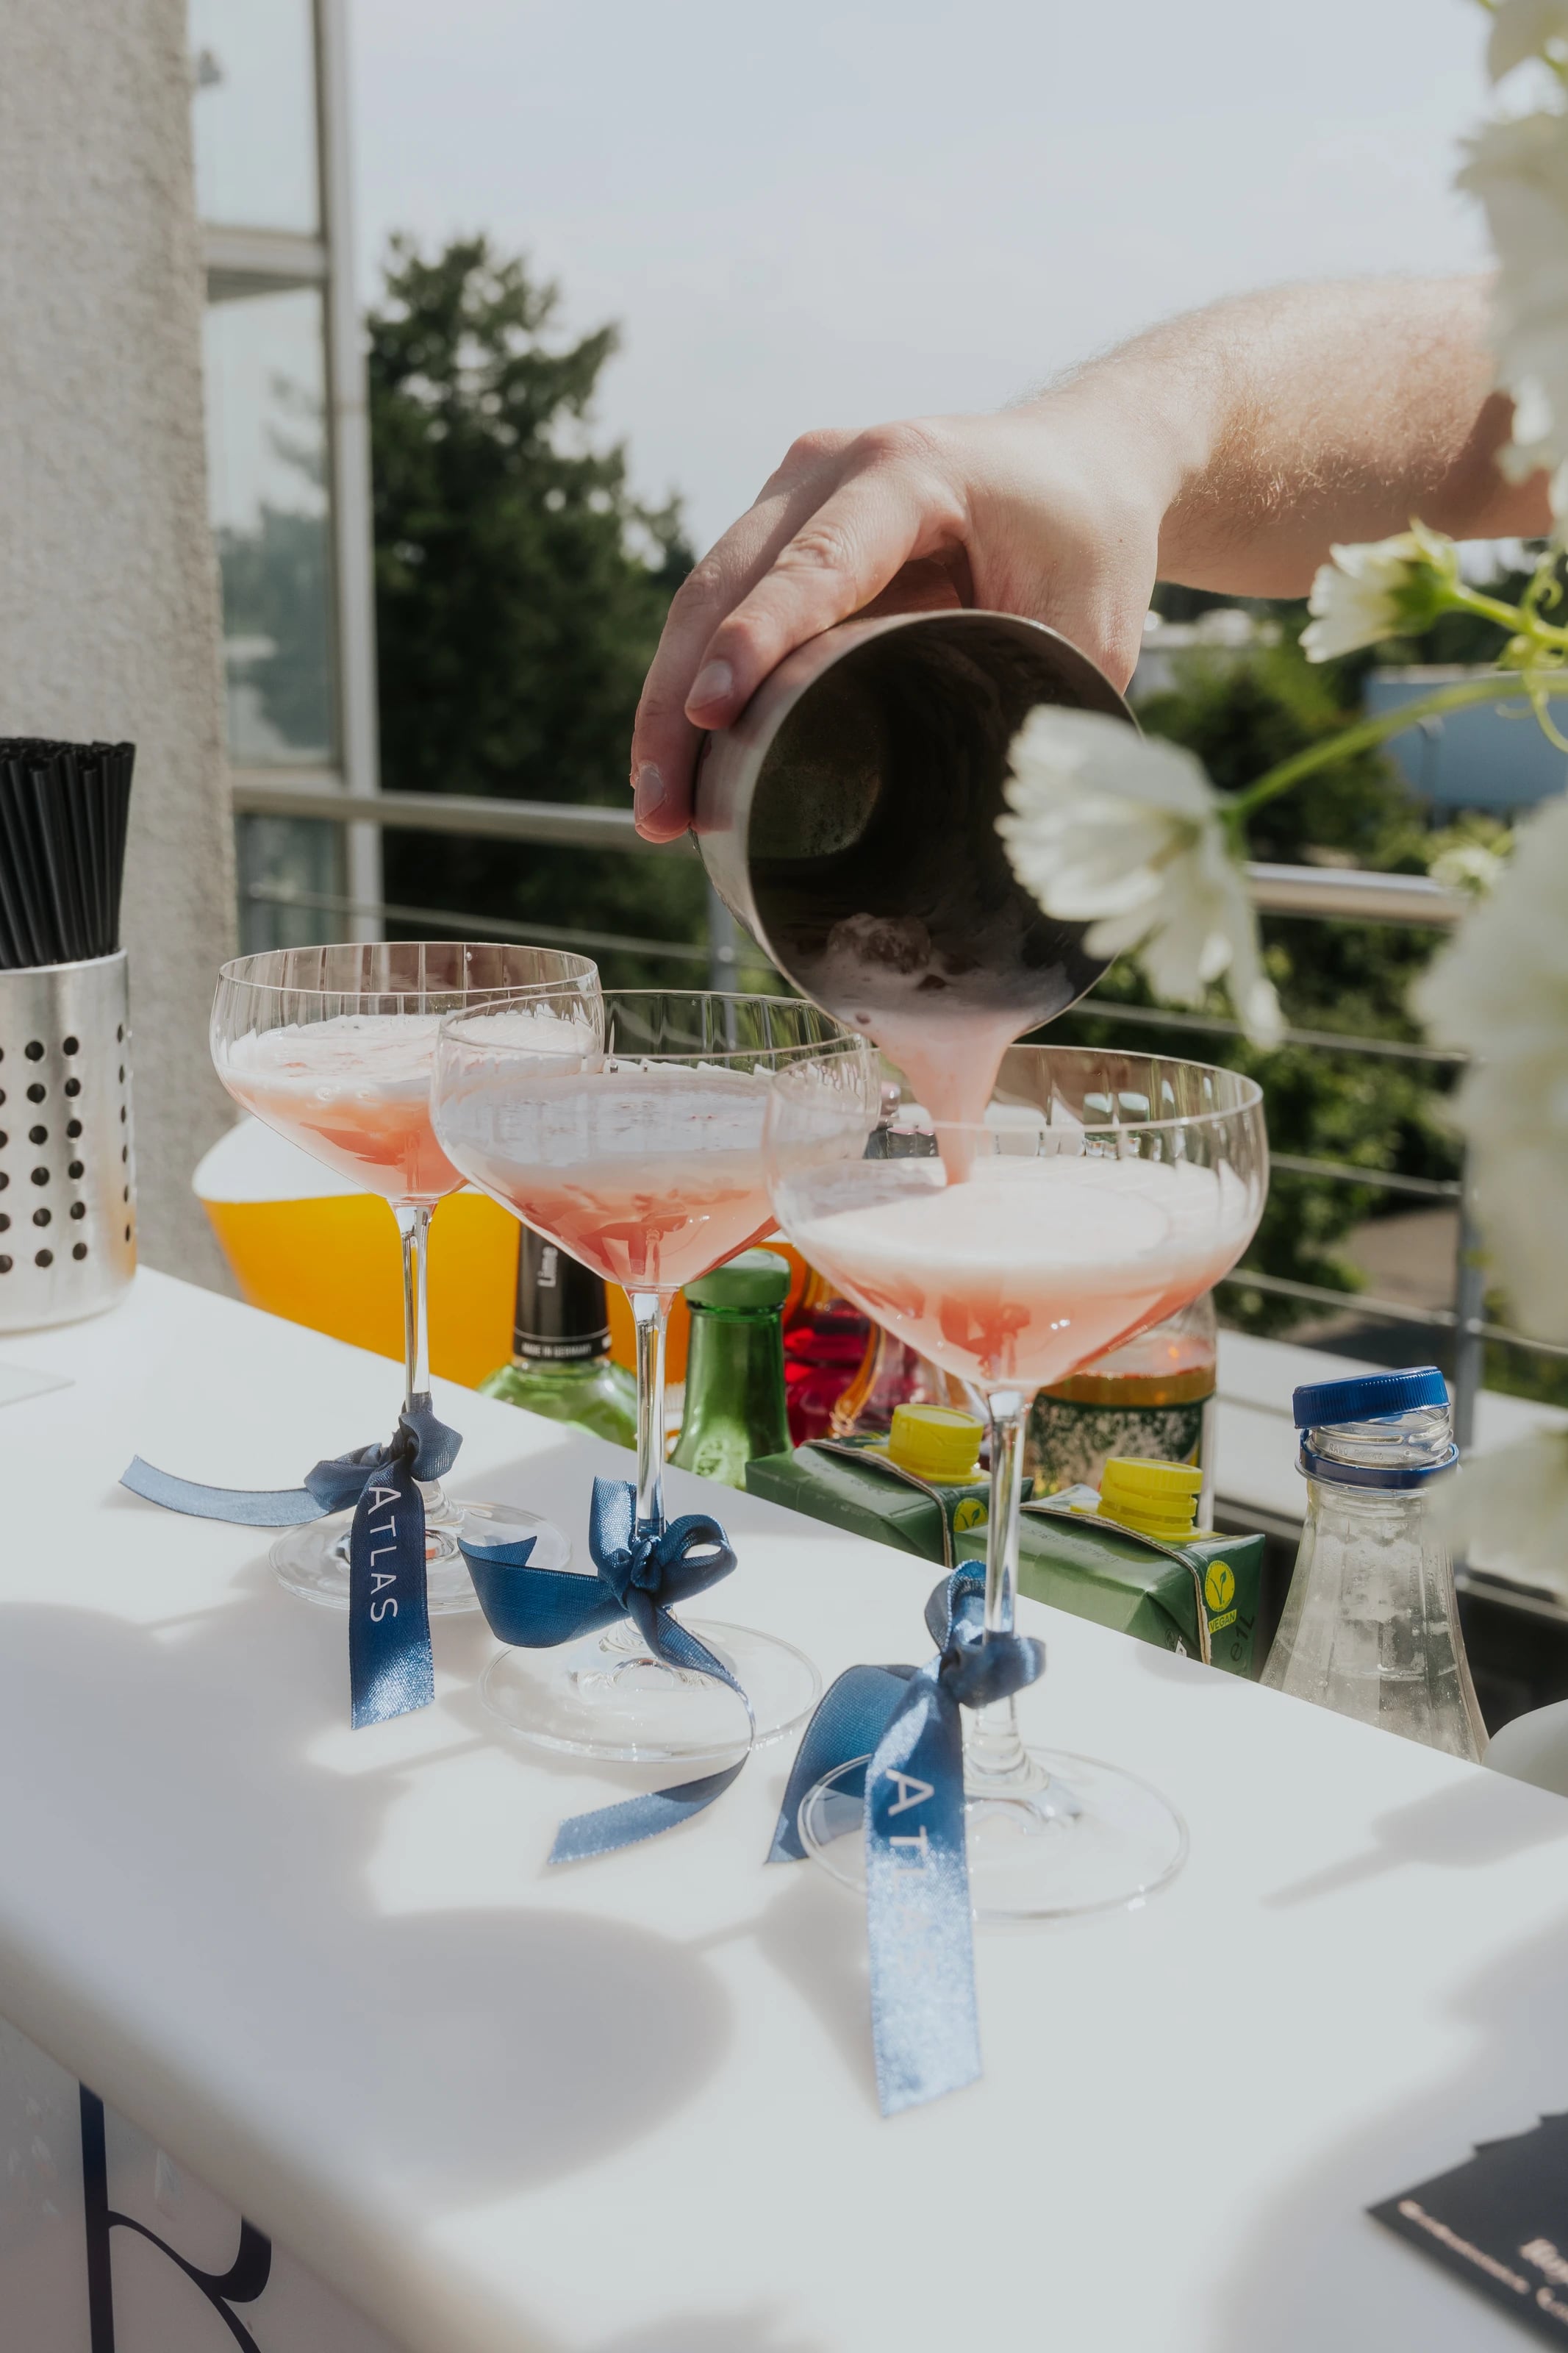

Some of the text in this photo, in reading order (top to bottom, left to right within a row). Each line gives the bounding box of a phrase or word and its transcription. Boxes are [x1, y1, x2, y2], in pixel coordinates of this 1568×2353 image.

[521, 1342, 592, 1358] MADE IN GERMANY
[368, 1487, 401, 1622] ATLAS
[1209, 1611, 1236, 1631] VEGAN
